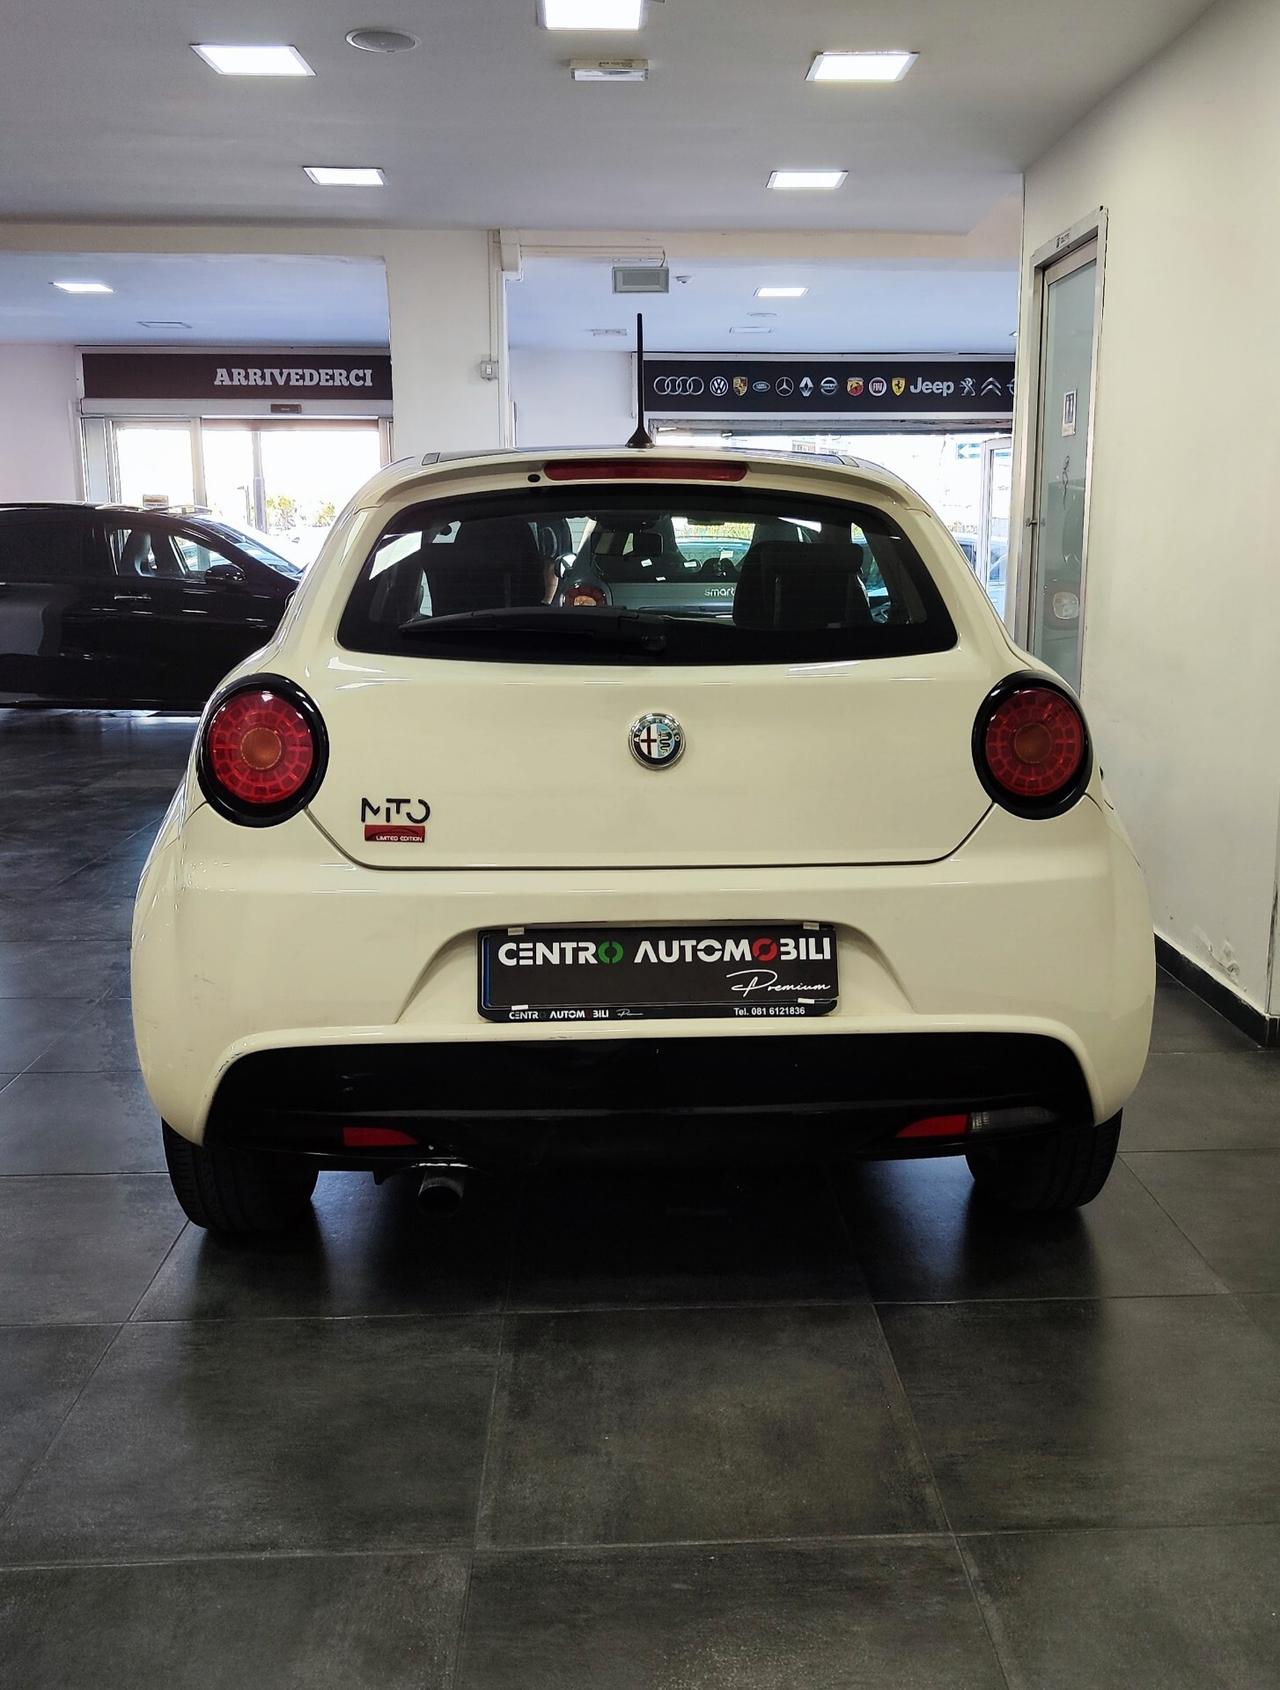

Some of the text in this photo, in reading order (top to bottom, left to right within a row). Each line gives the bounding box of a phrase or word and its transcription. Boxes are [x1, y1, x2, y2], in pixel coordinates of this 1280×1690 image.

[214, 368, 373, 387] ARRIVEDERCI
[909, 377, 954, 396] Jeep
[704, 587, 735, 597] smart
[498, 937, 831, 966] CENTRO AUTOMOBILI
[726, 969, 831, 997] Premium
[734, 1006, 806, 1016] Tel. 081 6121836
